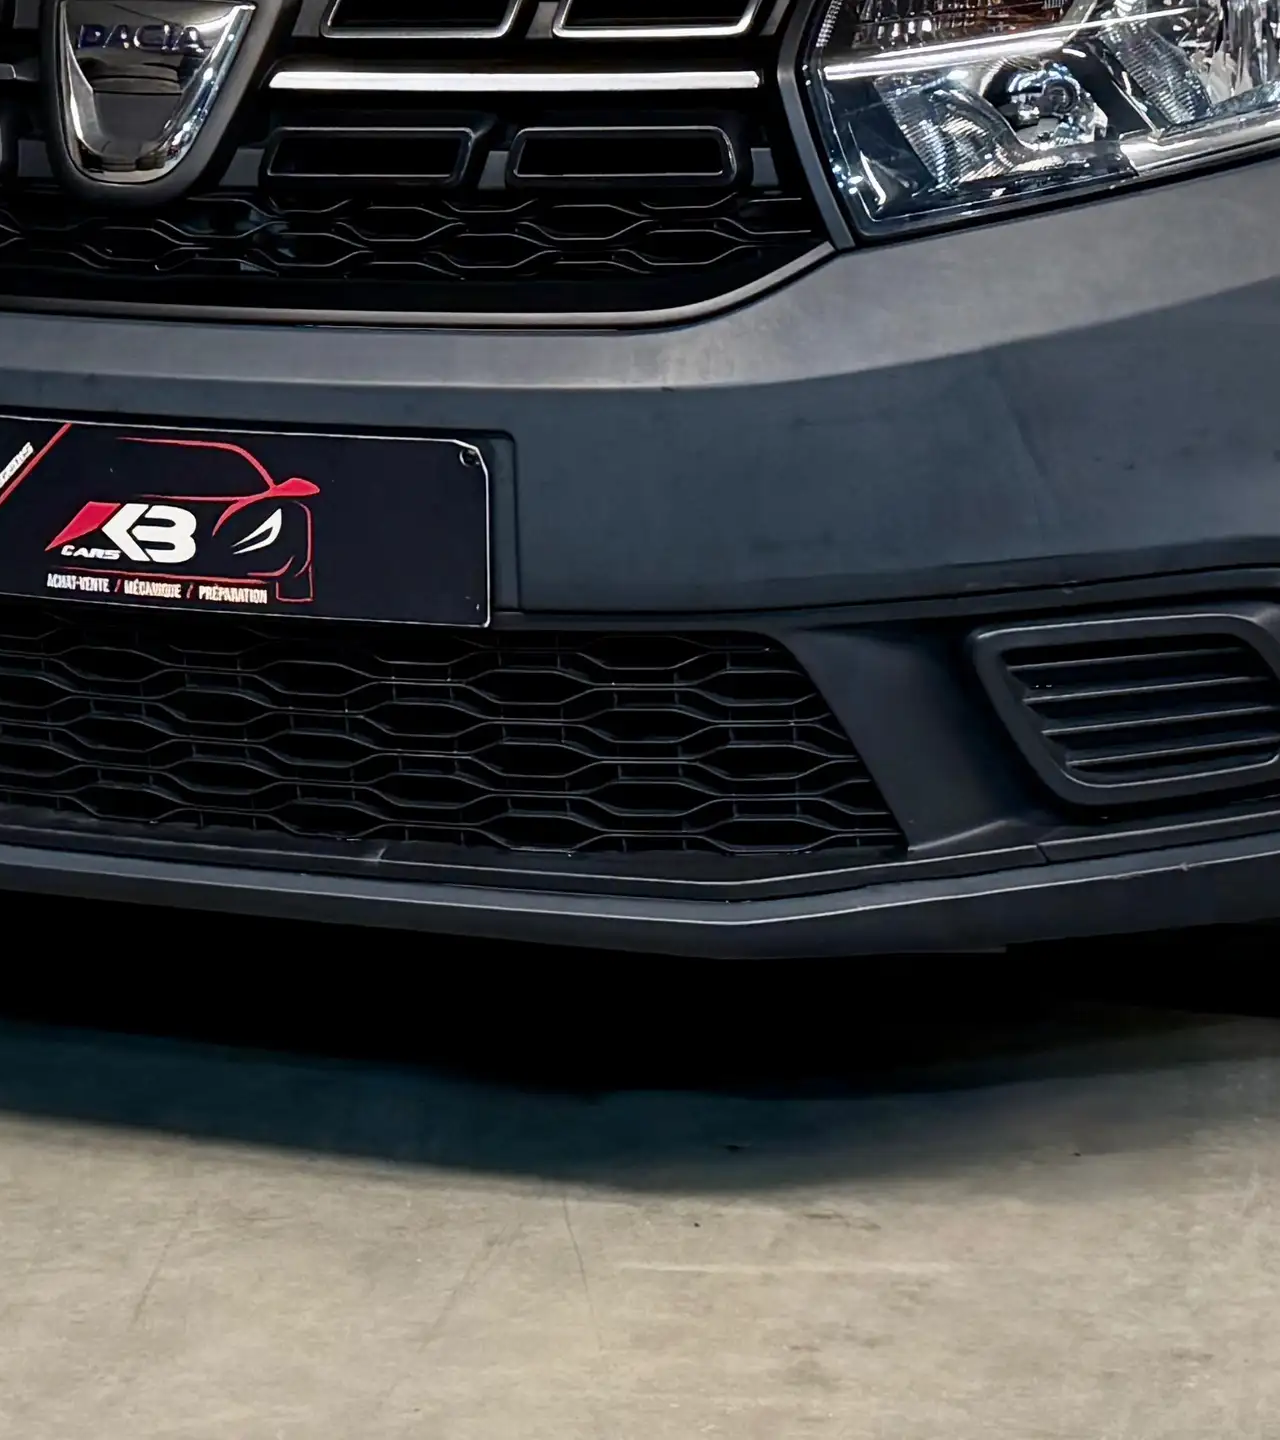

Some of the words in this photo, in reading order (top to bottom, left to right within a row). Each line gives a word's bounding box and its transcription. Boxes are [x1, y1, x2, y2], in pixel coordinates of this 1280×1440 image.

[77, 24, 211, 57] DACIA
[61, 545, 121, 560] CARS
[47, 573, 109, 593] ACHAT-VENTE
[199, 583, 267, 604] PRÉPARATION
